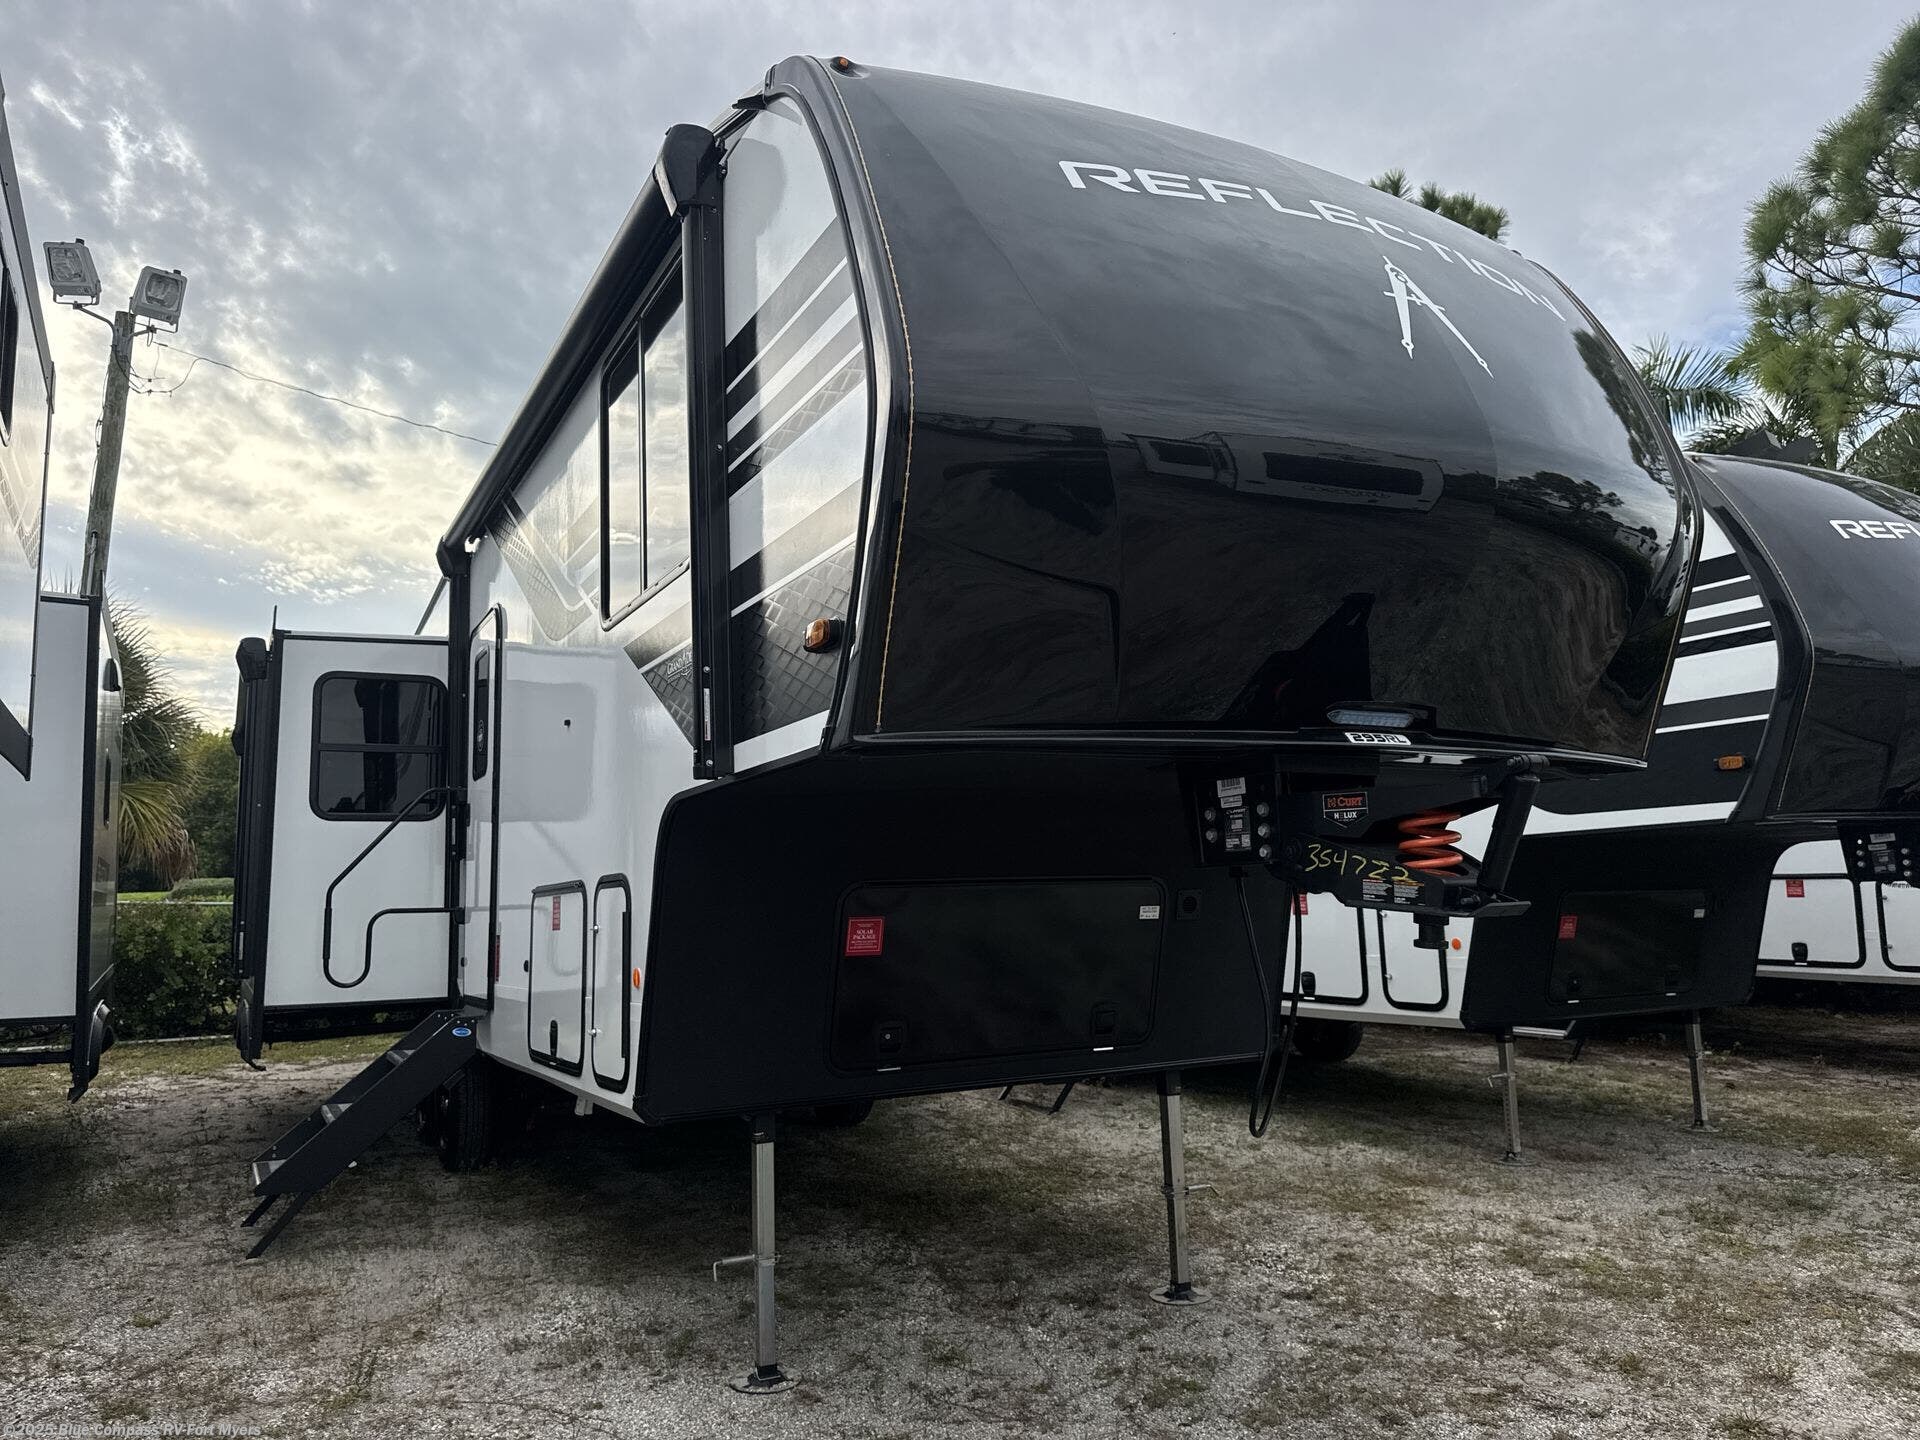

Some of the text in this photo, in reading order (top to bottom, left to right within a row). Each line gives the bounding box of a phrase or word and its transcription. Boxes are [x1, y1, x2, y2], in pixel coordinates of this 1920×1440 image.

[1058, 160, 1567, 322] REFLECTION
[1350, 733, 1408, 744] 295RL
[1304, 843, 1410, 881] 354722
